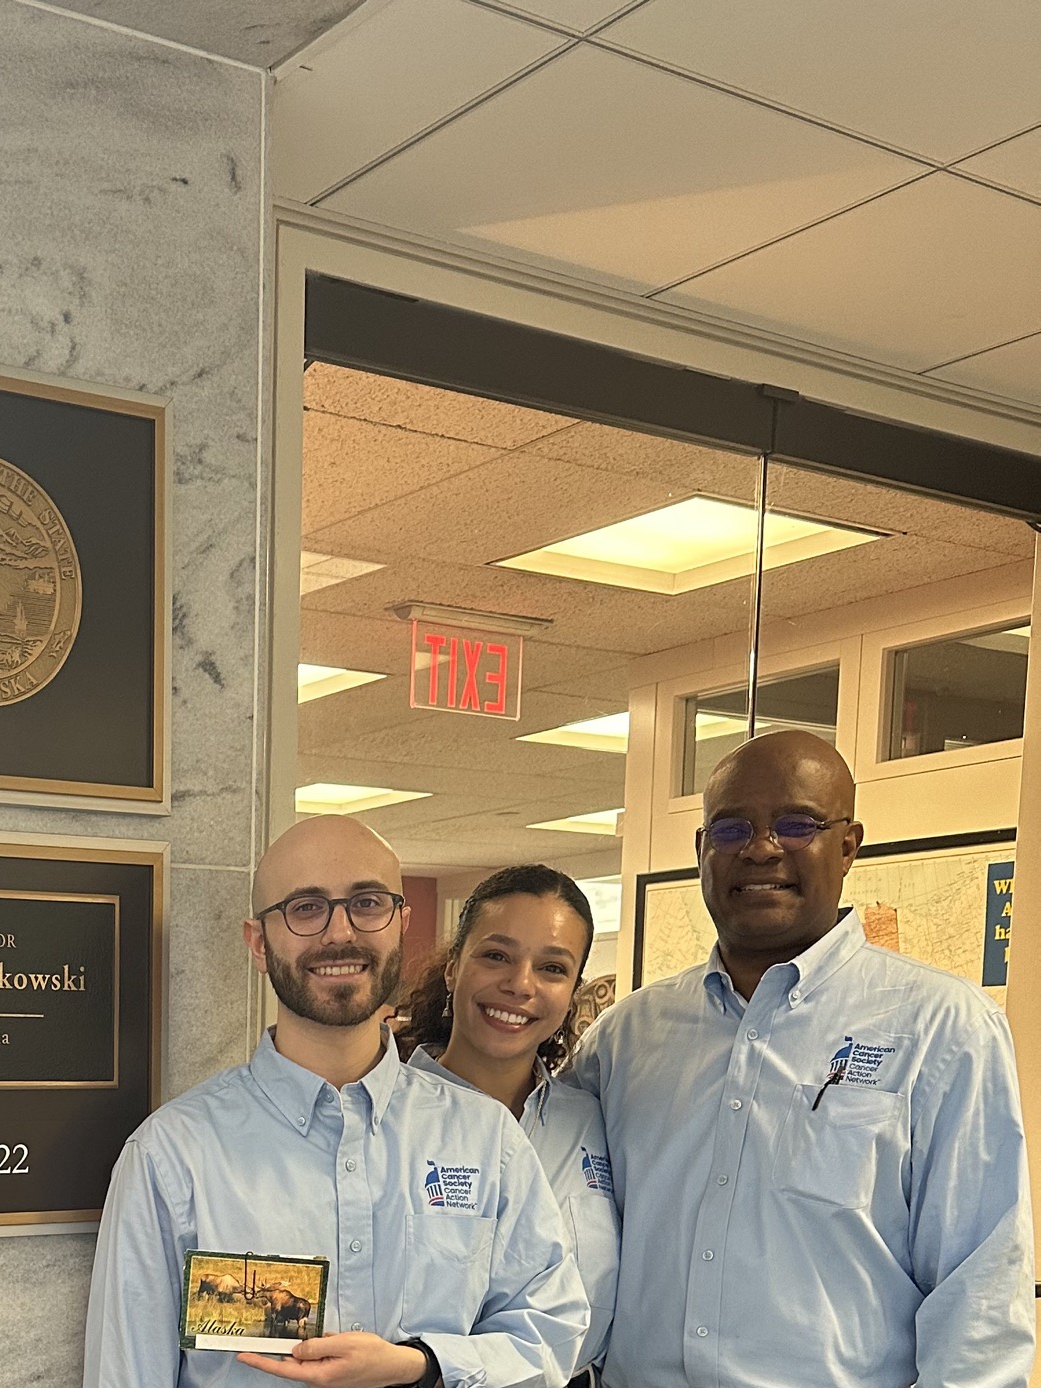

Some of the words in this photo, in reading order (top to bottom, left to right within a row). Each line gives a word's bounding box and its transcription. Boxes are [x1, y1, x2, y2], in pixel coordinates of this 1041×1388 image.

[39, 508, 75, 580] STATE
[854, 1043, 896, 1053] American
[852, 1050, 884, 1058] Cancer
[851, 1056, 883, 1067] Society
[849, 1063, 878, 1072] Cancer
[847, 1070, 872, 1078] Action
[441, 1165, 480, 1174] American
[443, 1180, 472, 1189] Society
[444, 1187, 471, 1195] Cancer
[446, 1194, 469, 1202] Action
[191, 1319, 246, 1336] Alaska
